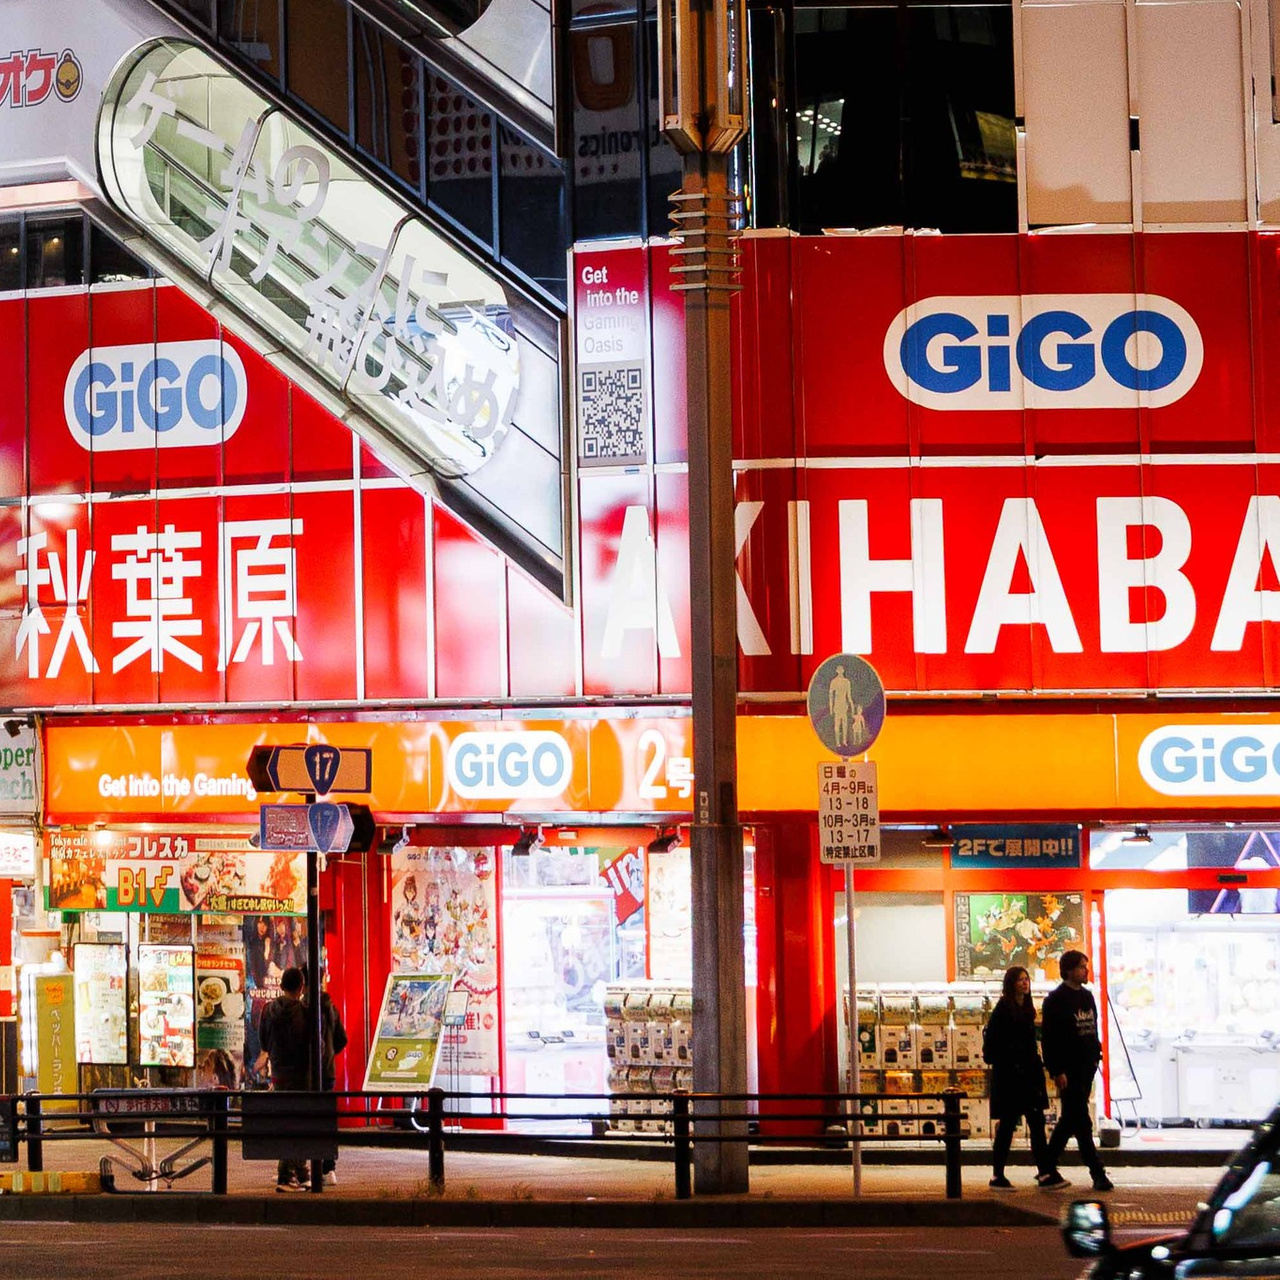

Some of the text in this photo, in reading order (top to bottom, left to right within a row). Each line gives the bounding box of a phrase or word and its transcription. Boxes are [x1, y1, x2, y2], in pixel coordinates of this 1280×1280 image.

[581, 266, 609, 285] Get
[586, 287, 639, 308] into the
[583, 335, 624, 354] Oasis
[899, 309, 1187, 394] GiGO
[72, 354, 238, 435] GiGO
[14, 517, 307, 680] 秋葉原
[314, 751, 334, 781] 17
[454, 741, 565, 788] GiGO
[1149, 734, 1280, 784] GiG
[99, 775, 127, 797] Get
[129, 773, 160, 797] into
[162, 773, 190, 797] the
[128, 836, 189, 859] フレスカ
[117, 866, 146, 907] B1
